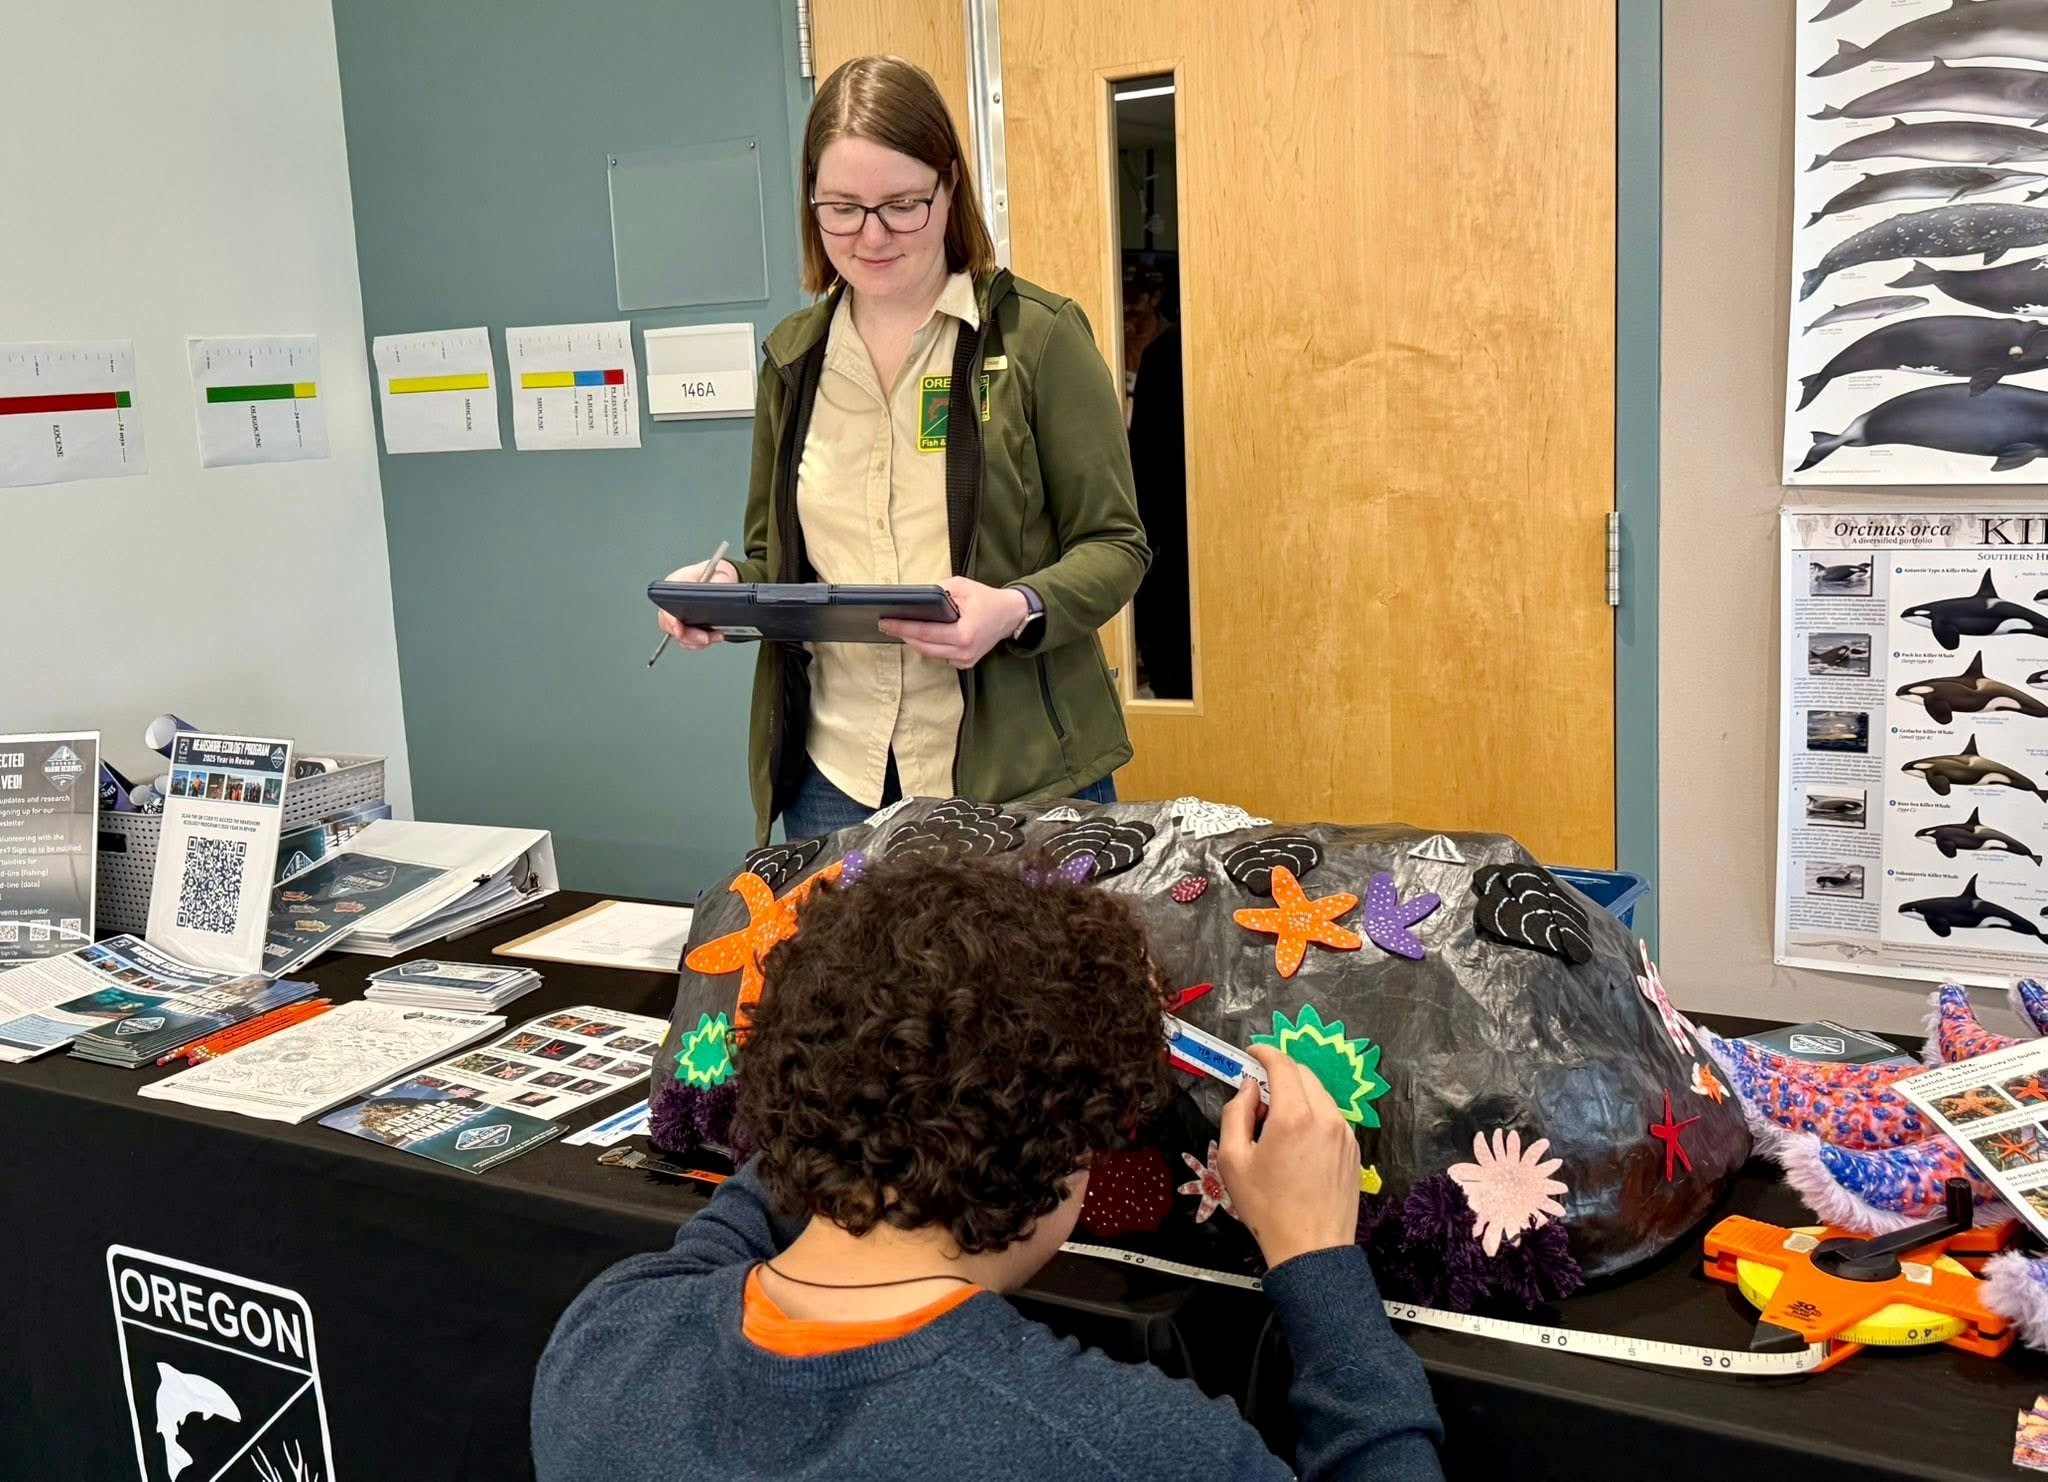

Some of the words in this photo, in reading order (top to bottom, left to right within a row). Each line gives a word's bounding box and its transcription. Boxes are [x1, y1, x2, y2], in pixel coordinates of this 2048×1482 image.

[681, 382, 716, 398] 146A
[611, 387, 619, 436] PLEISTOCENE
[250, 405, 262, 449] OLIGOCENE
[52, 424, 64, 458] EOCENE
[921, 439, 939, 447] Fish
[1835, 521, 1906, 536] Orcinus
[1911, 525, 1952, 536] orca
[1899, 537, 1933, 545] portfolio
[203, 754, 216, 763] 2025
[216, 755, 229, 764] Year
[235, 757, 256, 766] Review
[0, 774, 22, 790] VED!
[41, 795, 71, 803] research
[120, 1268, 304, 1359] OREGON
[1392, 1306, 1416, 1319] 70
[1541, 1333, 1567, 1347] 80
[1702, 1356, 1731, 1368] 90
